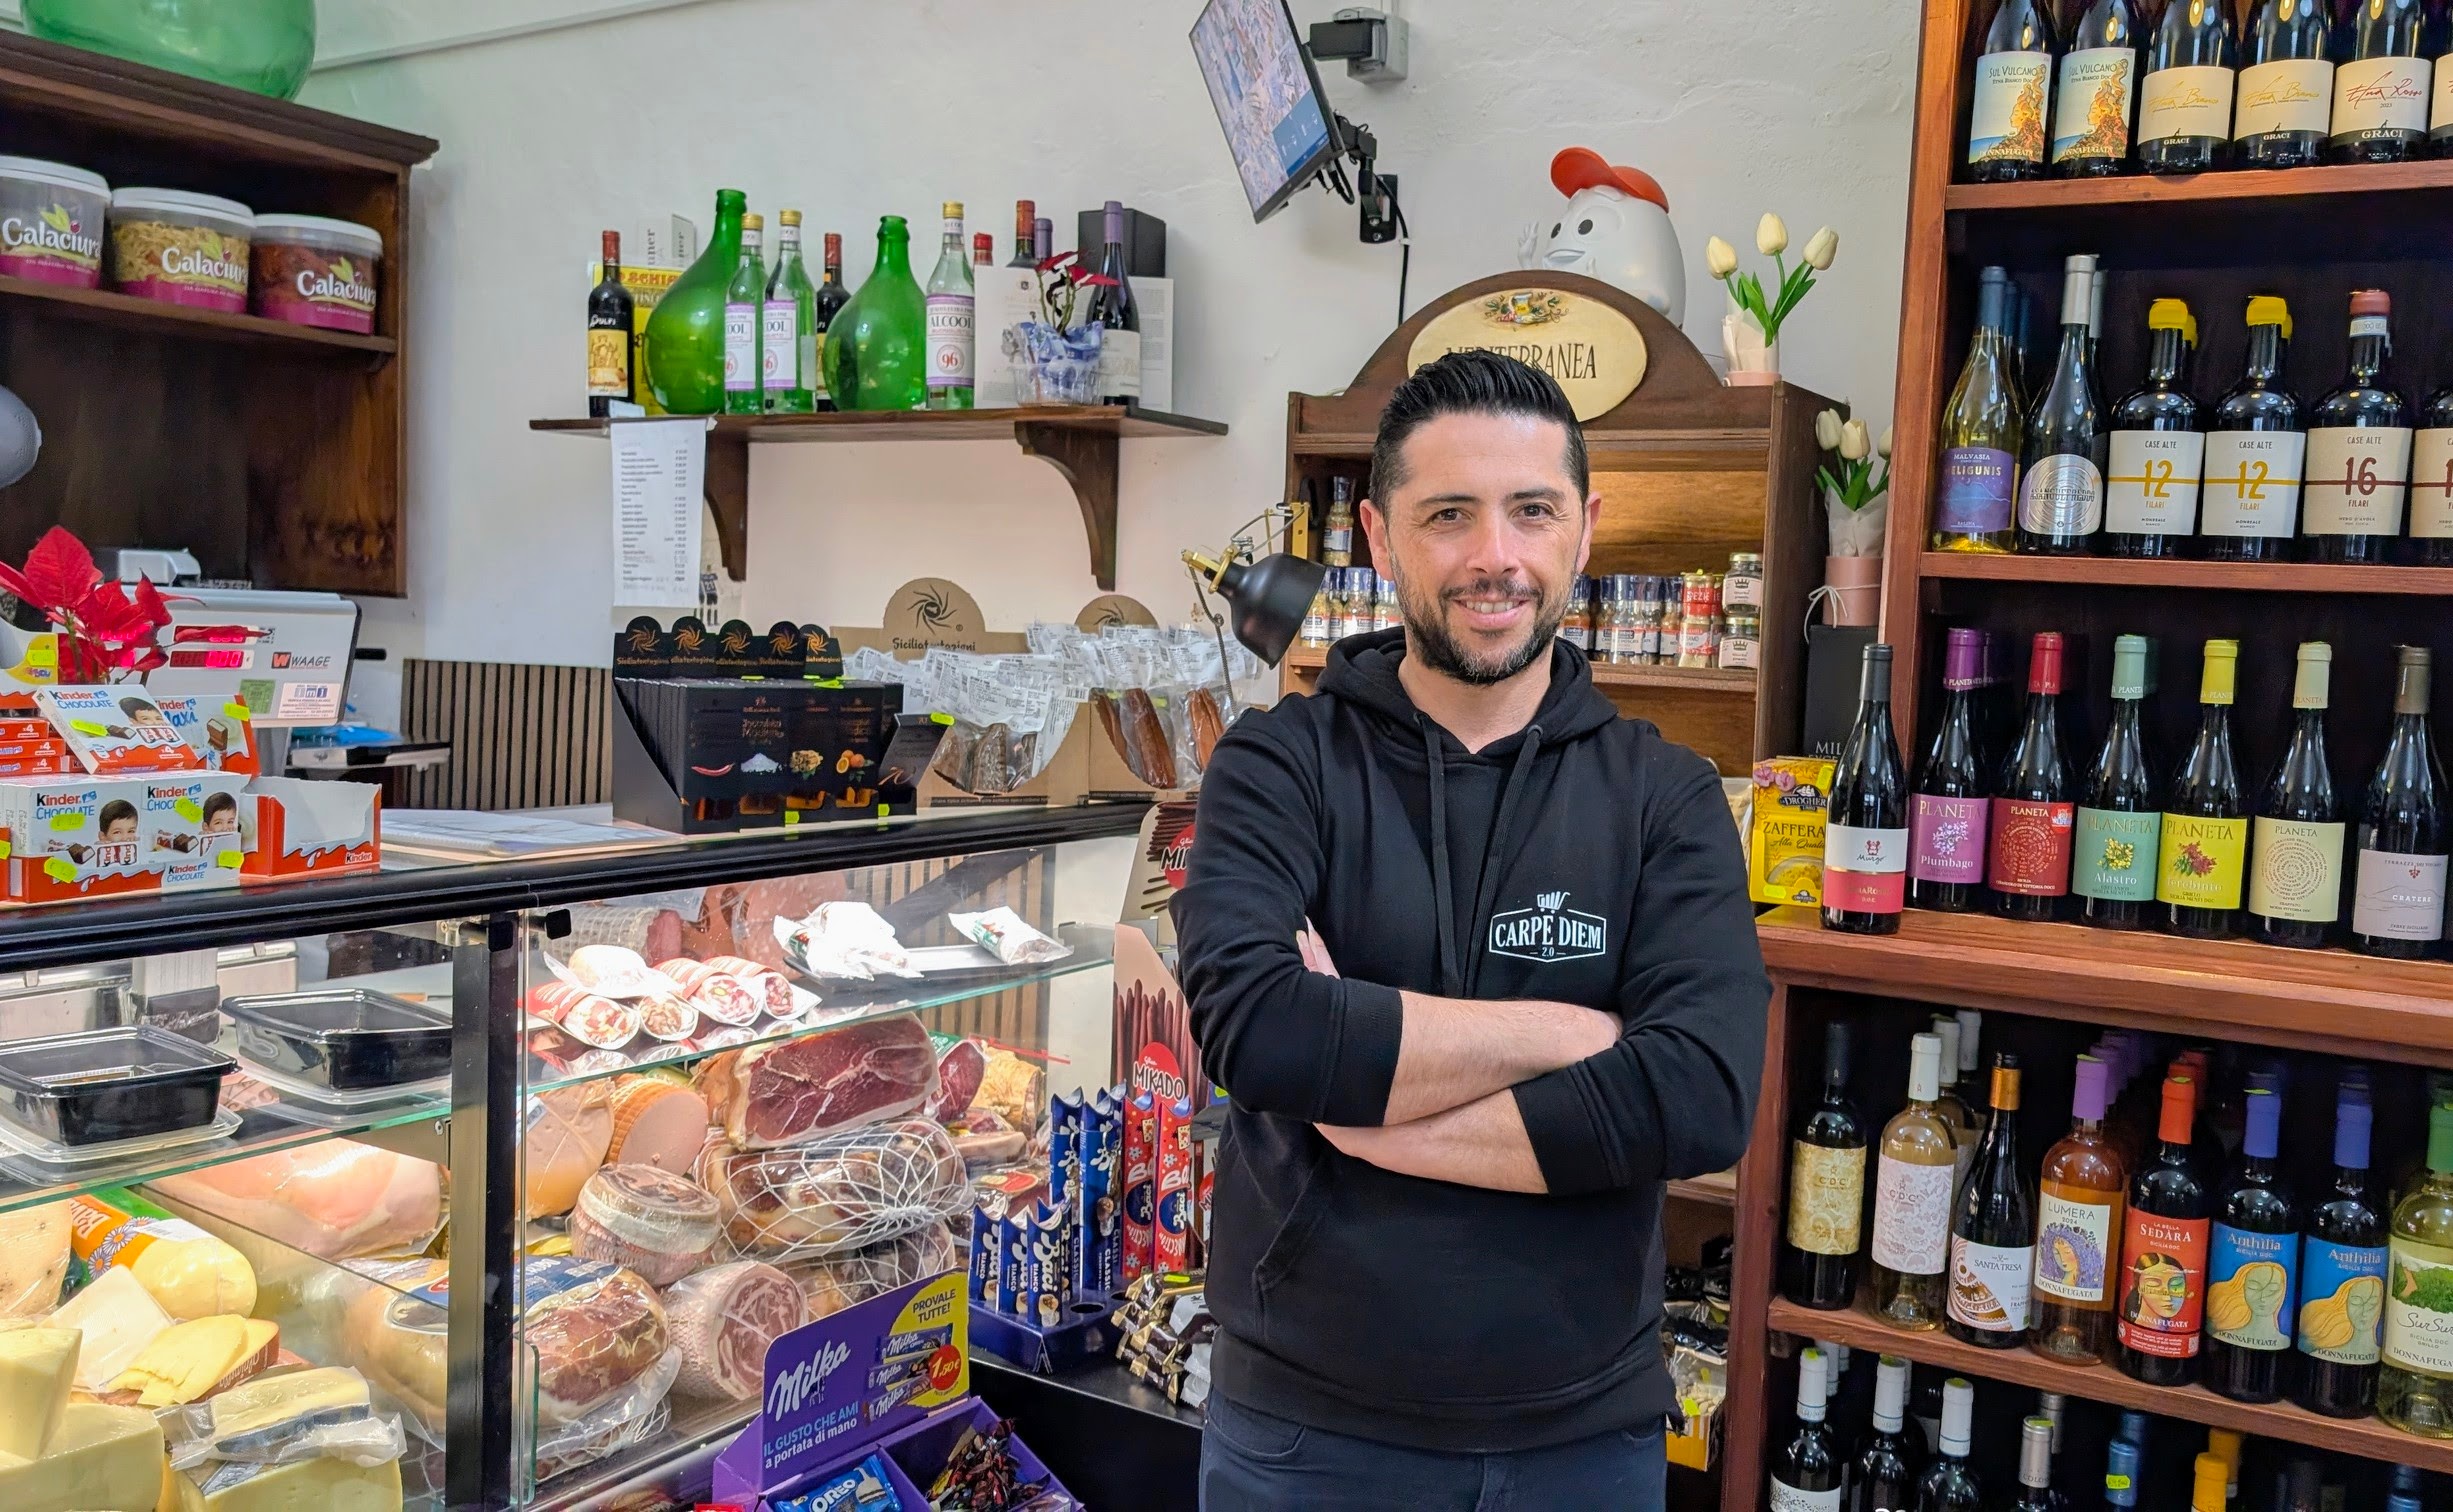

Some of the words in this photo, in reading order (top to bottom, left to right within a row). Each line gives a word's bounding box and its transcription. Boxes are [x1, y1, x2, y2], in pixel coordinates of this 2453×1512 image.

[2164, 137, 2190, 146] GRACI
[2263, 132, 2290, 141] GRACI
[2362, 129, 2403, 139] GRACI
[942, 353, 958, 367] 96
[2162, 441, 2177, 449] ALTE
[2239, 441, 2255, 449] CASE
[2257, 441, 2272, 449] ALTE
[2347, 436, 2363, 444] CASE
[2366, 436, 2382, 444] ALTE
[2143, 460, 2173, 497] 12
[2238, 460, 2269, 499] 12
[2345, 457, 2377, 495] 16
[290, 656, 331, 667] WAAGE
[57, 699, 115, 710] CHOCOLATE
[1919, 800, 1982, 820] PLANETA
[2010, 806, 2049, 817] PLANETA
[1763, 821, 1825, 838] ZAFFERA
[2087, 815, 2153, 834] PLANETA
[2166, 820, 2234, 841] PLANETA
[2275, 825, 2318, 838] PLANETA
[1921, 855, 1974, 869] Plumbago
[166, 871, 205, 884] CHOCOLATE
[2094, 873, 2137, 885] Alastro
[1495, 915, 1554, 948] CARPE
[1558, 916, 1602, 950] DIEM
[1541, 947, 1554, 957] 2.0
[1133, 1061, 1185, 1101] MIKADO
[2048, 1201, 2095, 1220] LUMERA
[1033, 1232, 1058, 1294] Baci
[1974, 1259, 2000, 1271] SANTA
[2001, 1263, 2023, 1271] TRESA
[2039, 1278, 2094, 1297] DONNAFUGATA
[912, 1288, 957, 1314] PROVALE
[918, 1302, 951, 1323] TUTTE!
[2130, 1310, 2189, 1328] DONNAFUGATA
[886, 1332, 919, 1356] Milka
[2218, 1331, 2278, 1347] DONNAFUGATA
[2318, 1348, 2375, 1361] DONNAFUGATA
[767, 1339, 851, 1422] Milka
[876, 1363, 903, 1387] Milka
[875, 1387, 906, 1418] Milka
[763, 1444, 776, 1457] IL
[777, 1424, 812, 1452] GUSTO
[813, 1414, 836, 1436] CHE
[837, 1405, 859, 1427] AMI
[765, 1459, 773, 1468] a
[774, 1433, 814, 1468] portata
[815, 1430, 825, 1444] di
[828, 1417, 858, 1440] mano
[811, 1479, 856, 1512] OREO
